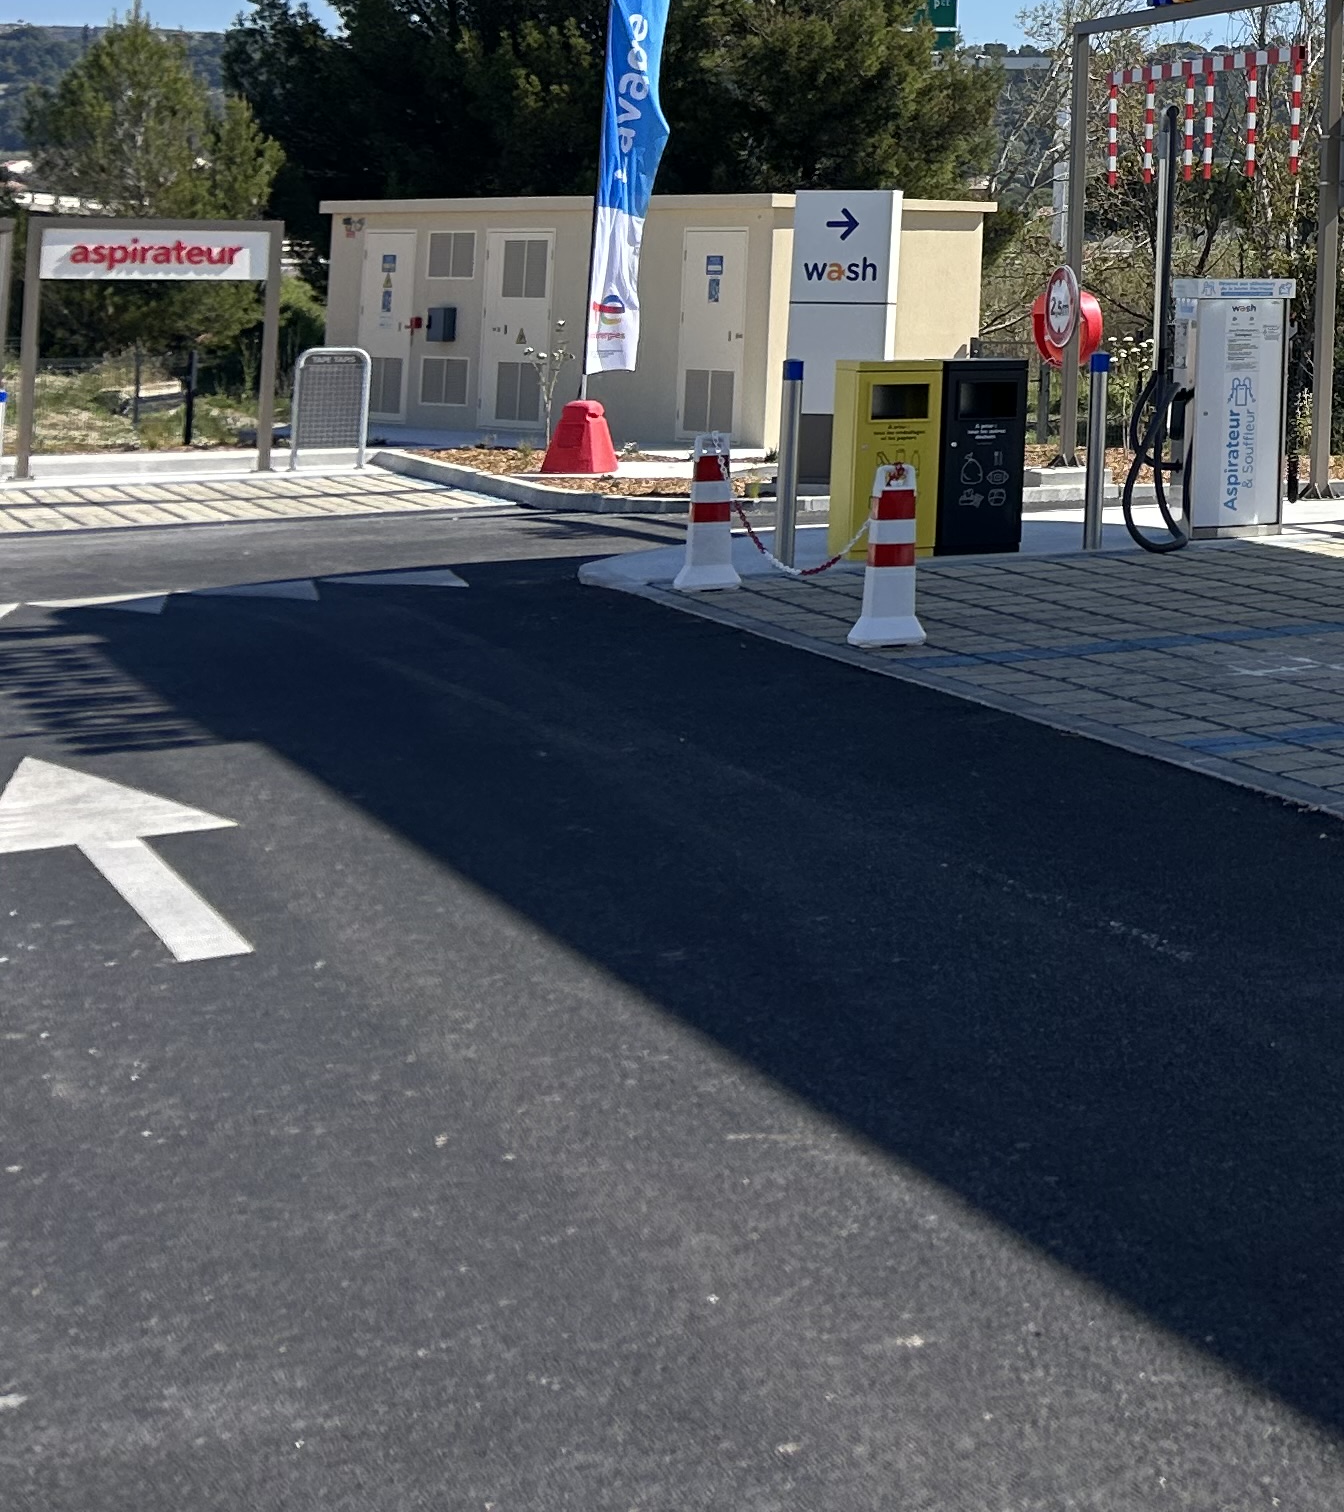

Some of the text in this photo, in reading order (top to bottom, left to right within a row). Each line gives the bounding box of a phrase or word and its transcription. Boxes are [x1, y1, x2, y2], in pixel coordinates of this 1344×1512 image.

[70, 238, 243, 271] aspirateur
[803, 256, 878, 282] wash
[1231, 304, 1257, 313] wash
[1223, 409, 1241, 511] Aspirateur
[1241, 409, 1256, 489] & Souffleur
